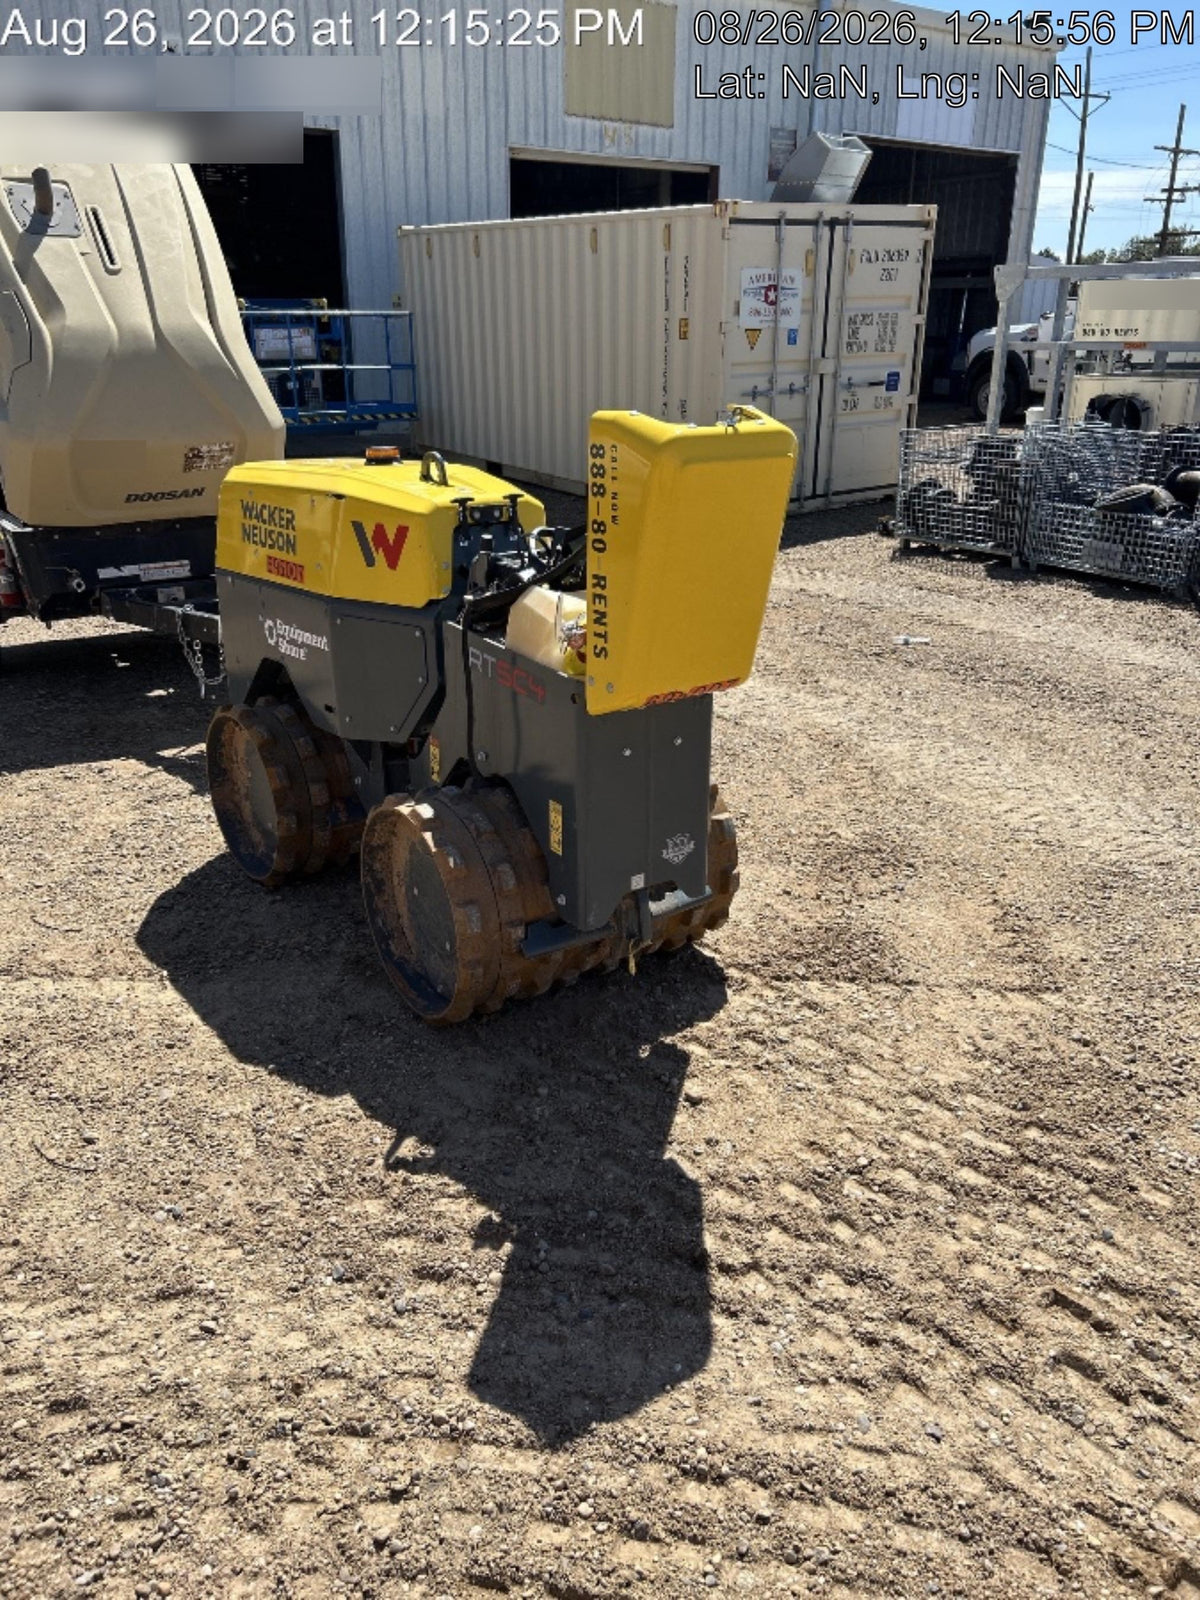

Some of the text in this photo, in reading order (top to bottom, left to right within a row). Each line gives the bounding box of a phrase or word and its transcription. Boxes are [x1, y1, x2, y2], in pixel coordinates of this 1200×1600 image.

[748, 273, 796, 285] AMERIAN
[124, 487, 206, 504] DOOSAN
[611, 492, 619, 525] NOW
[240, 499, 296, 532] WACKER
[241, 522, 297, 556] NEUSON
[276, 618, 330, 652] Equipment
[279, 637, 307, 661] Share
